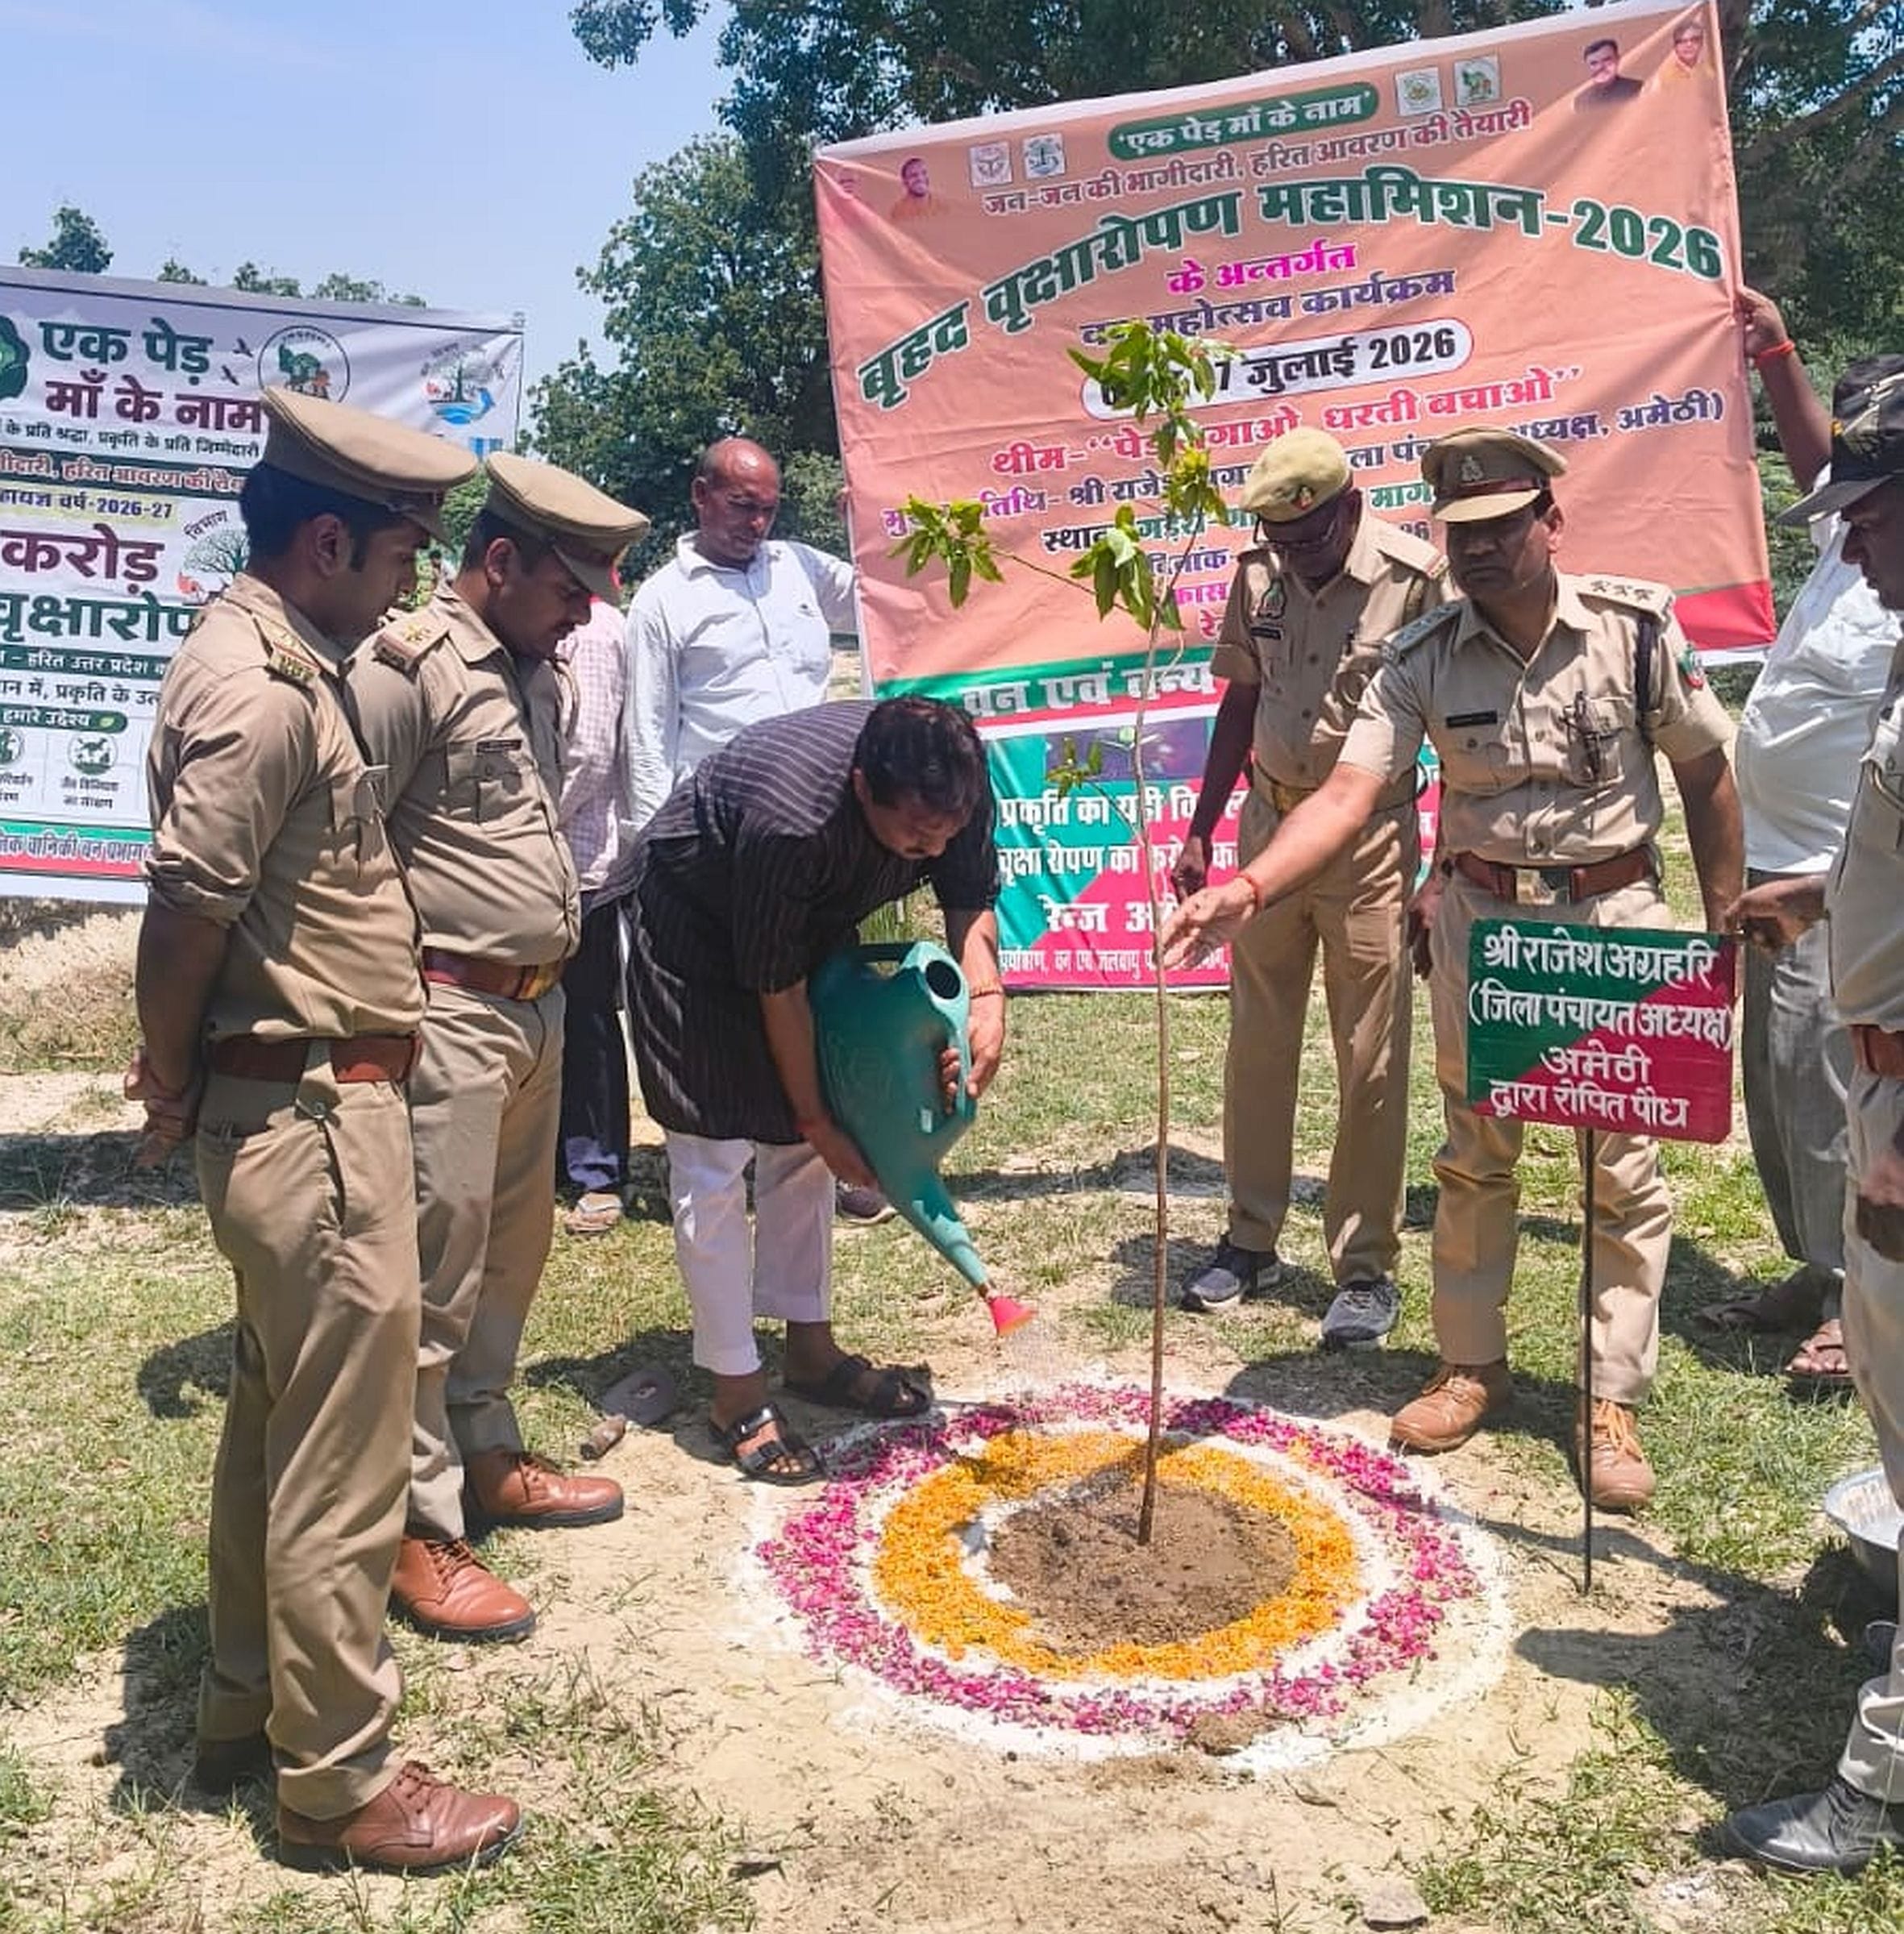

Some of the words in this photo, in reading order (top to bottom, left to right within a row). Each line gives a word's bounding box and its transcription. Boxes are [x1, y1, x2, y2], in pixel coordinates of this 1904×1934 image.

[1179, 115, 1221, 143] पेड़
[1266, 100, 1298, 127] के
[984, 182, 1082, 214] जन-जन
[1087, 170, 1121, 199] की
[1250, 142, 1311, 177] हरित
[1317, 127, 1407, 162] आवरण
[1413, 114, 1449, 145] की
[1453, 99, 1532, 135] तैयारी
[981, 190, 1245, 335] वृक्षारोपण
[1166, 259, 1206, 295] के
[1216, 238, 1357, 289] अन्तर्गत
[1301, 270, 1456, 315] कार्यक्रम
[39, 321, 131, 364] एक
[142, 317, 214, 385] पेड़
[1241, 337, 1360, 394] जुलाई
[1369, 327, 1456, 371] 2026
[45, 368, 106, 419] माँ
[114, 374, 164, 423] के
[175, 393, 263, 435] नाम
[1324, 390, 1417, 430] धरती
[26, 423, 52, 440] प्रति
[98, 430, 139, 450] प्रकृति
[144, 431, 160, 448] के
[164, 436, 191, 453] प्रति
[1070, 476, 1105, 506] श्री
[1618, 388, 1724, 431] अमेठी)
[185, 468, 211, 491] की
[0, 523, 164, 595] करोड़
[27, 647, 64, 668] हरित
[70, 655, 106, 672] उत्तर
[110, 656, 148, 675] प्रदेश
[1037, 660, 1116, 711] एवं
[3, 706, 40, 723] हमारे
[56, 683, 106, 704] प्रकृति
[112, 685, 129, 702] के
[1000, 790, 1070, 835] प्रकृति
[1077, 793, 1110, 826] का
[1109, 845, 1139, 875] का
[1483, 925, 1524, 970] श्री
[1523, 926, 1604, 976] राजेश
[1605, 938, 1721, 991] अग्रहरि
[1469, 978, 1544, 1026] (जिला
[1545, 988, 1636, 1037] पंचायत
[1637, 1001, 1733, 1052] अध्यक्ष)
[1540, 1039, 1652, 1084] अमेठी
[1489, 1079, 1549, 1118] द्वारा
[1553, 1079, 1626, 1124] रोपित
[1631, 1086, 1691, 1129] पौध
